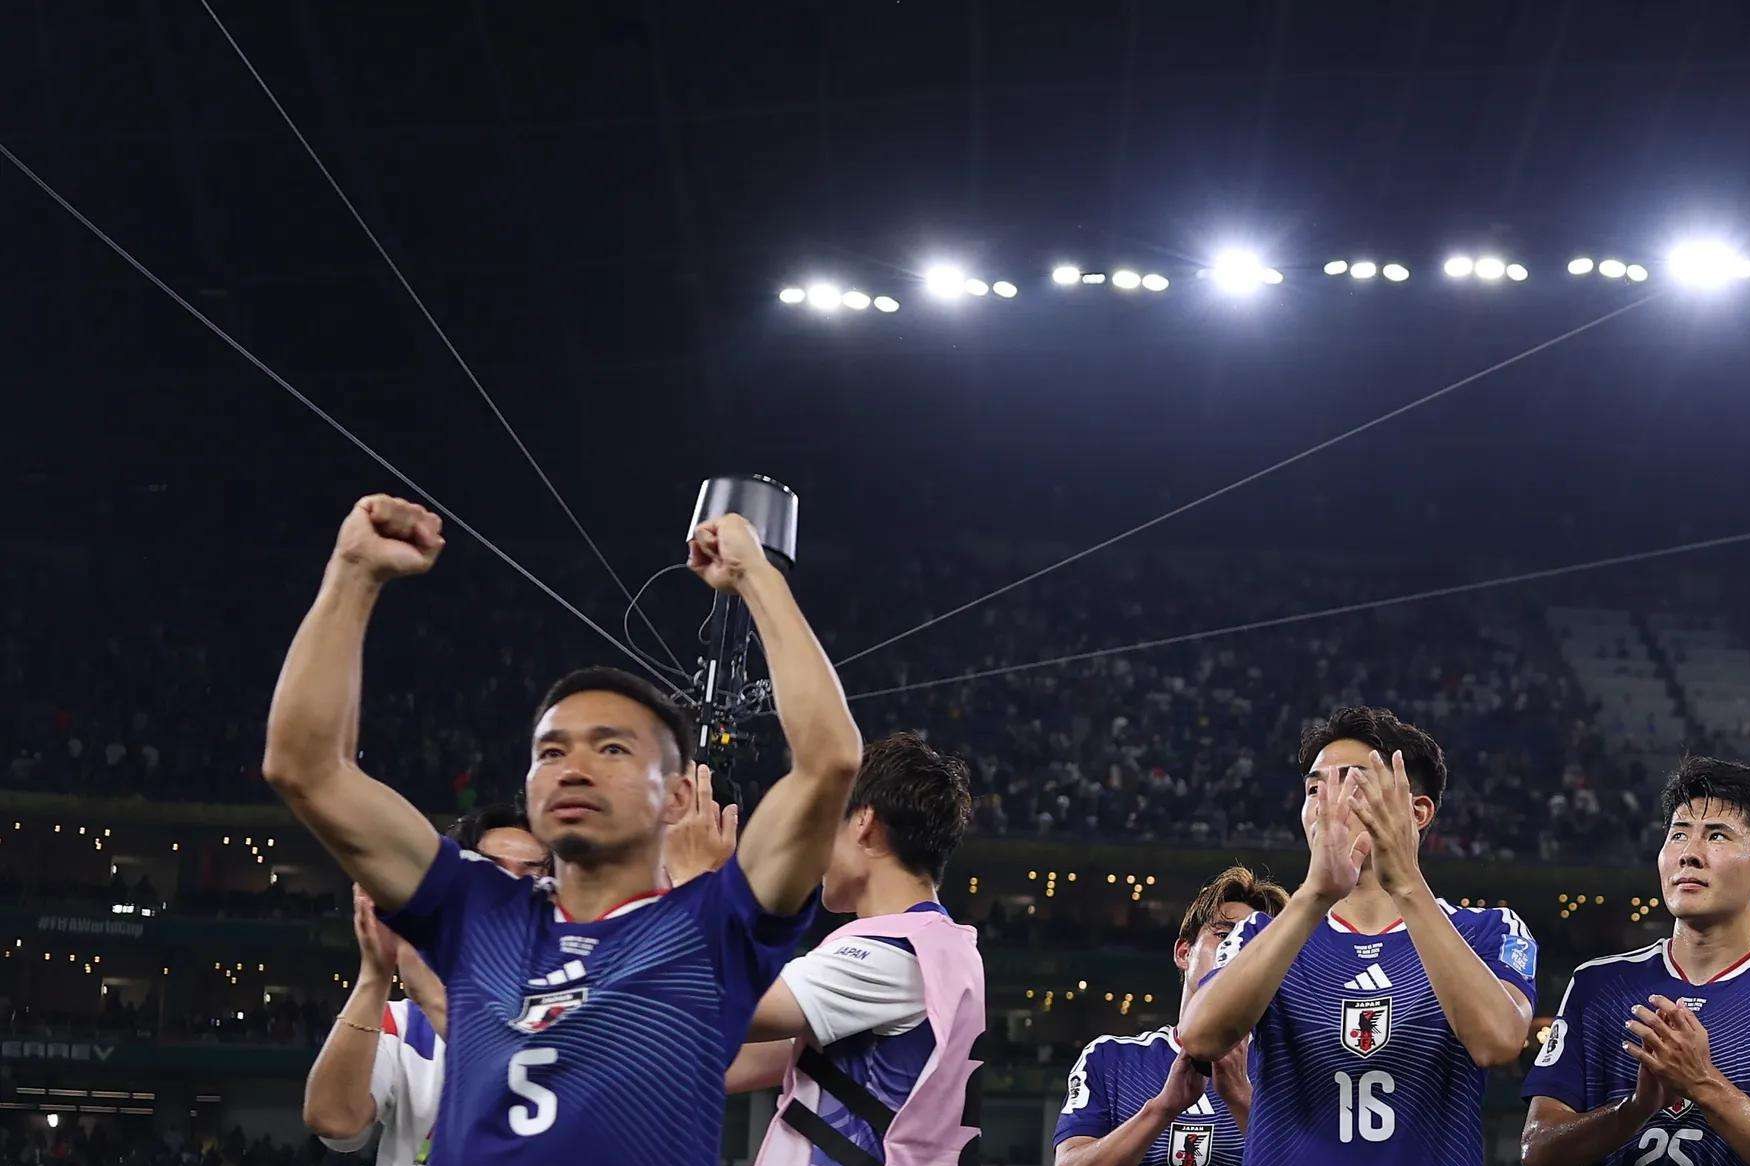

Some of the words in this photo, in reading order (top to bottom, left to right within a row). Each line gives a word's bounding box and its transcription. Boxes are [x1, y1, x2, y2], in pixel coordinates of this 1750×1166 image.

[1354, 1000, 1381, 1008] JAPAN
[508, 1047, 558, 1136] 5
[1334, 1070, 1395, 1143] 16
